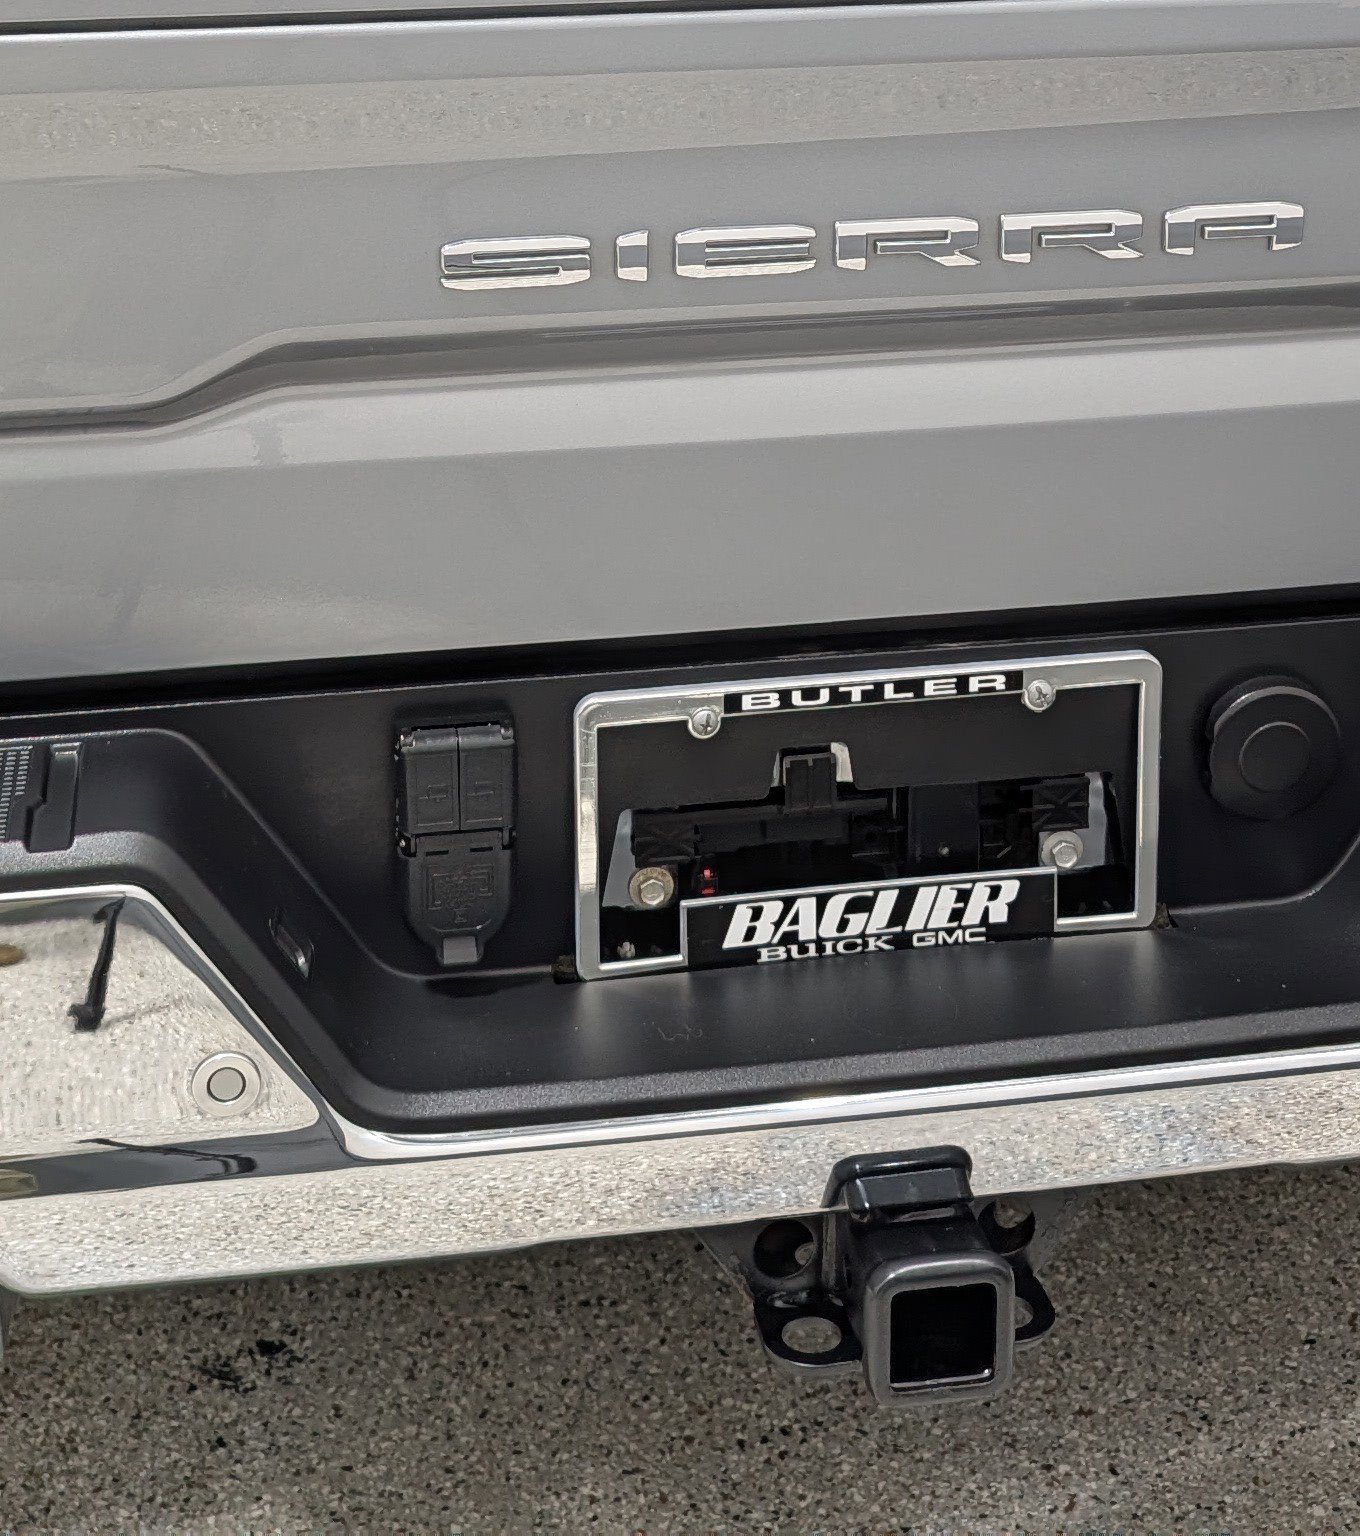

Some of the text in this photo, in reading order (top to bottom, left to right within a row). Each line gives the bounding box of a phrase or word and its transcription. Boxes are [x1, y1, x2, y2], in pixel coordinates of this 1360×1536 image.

[439, 201, 1305, 291] SIERRA
[741, 674, 1007, 712] BUTLER
[721, 879, 1021, 950] BAGLIER
[756, 927, 987, 964] BUICK GMC
